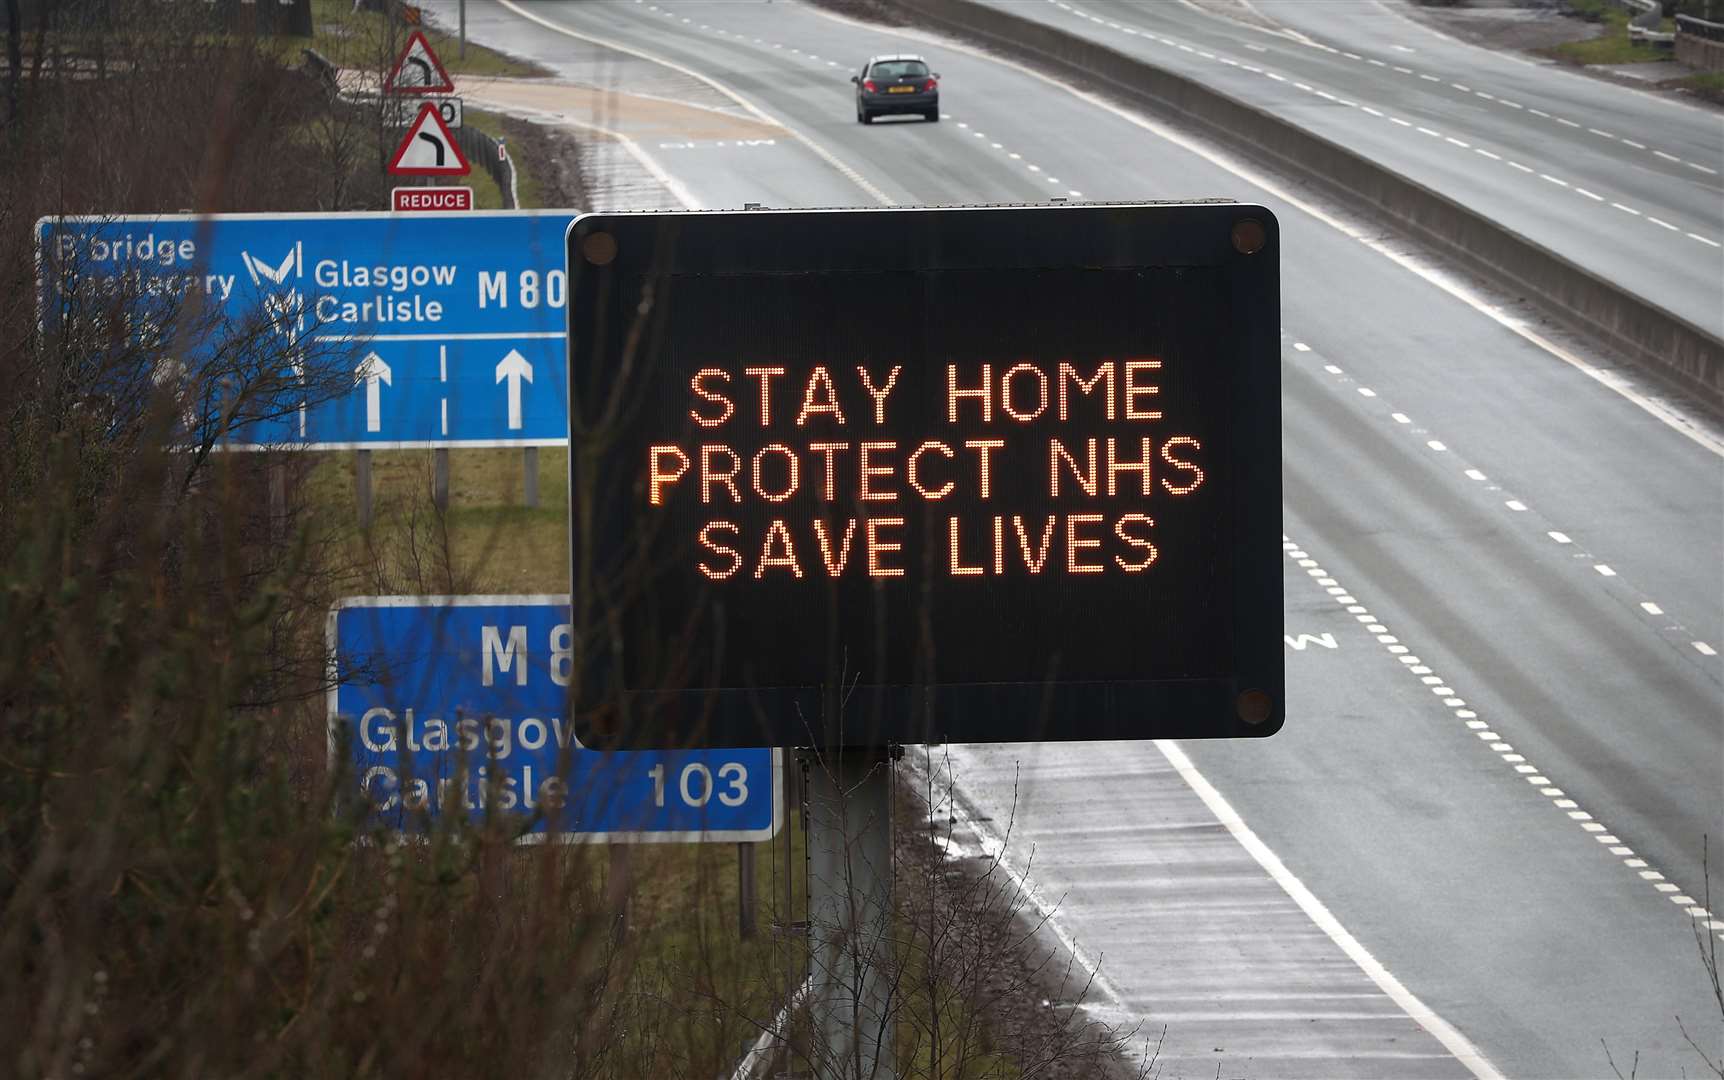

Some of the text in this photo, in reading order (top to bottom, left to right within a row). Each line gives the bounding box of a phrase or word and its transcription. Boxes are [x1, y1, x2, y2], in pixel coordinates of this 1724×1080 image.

[400, 194, 465, 209] REDUCE
[314, 259, 457, 291] Glasgow
[315, 294, 443, 322] Carlisle
[691, 361, 1161, 426] STAY HOME
[651, 437, 1203, 504] PROTECT NHS
[699, 514, 1157, 579] SAVE LIVES
[648, 762, 749, 808] 103
